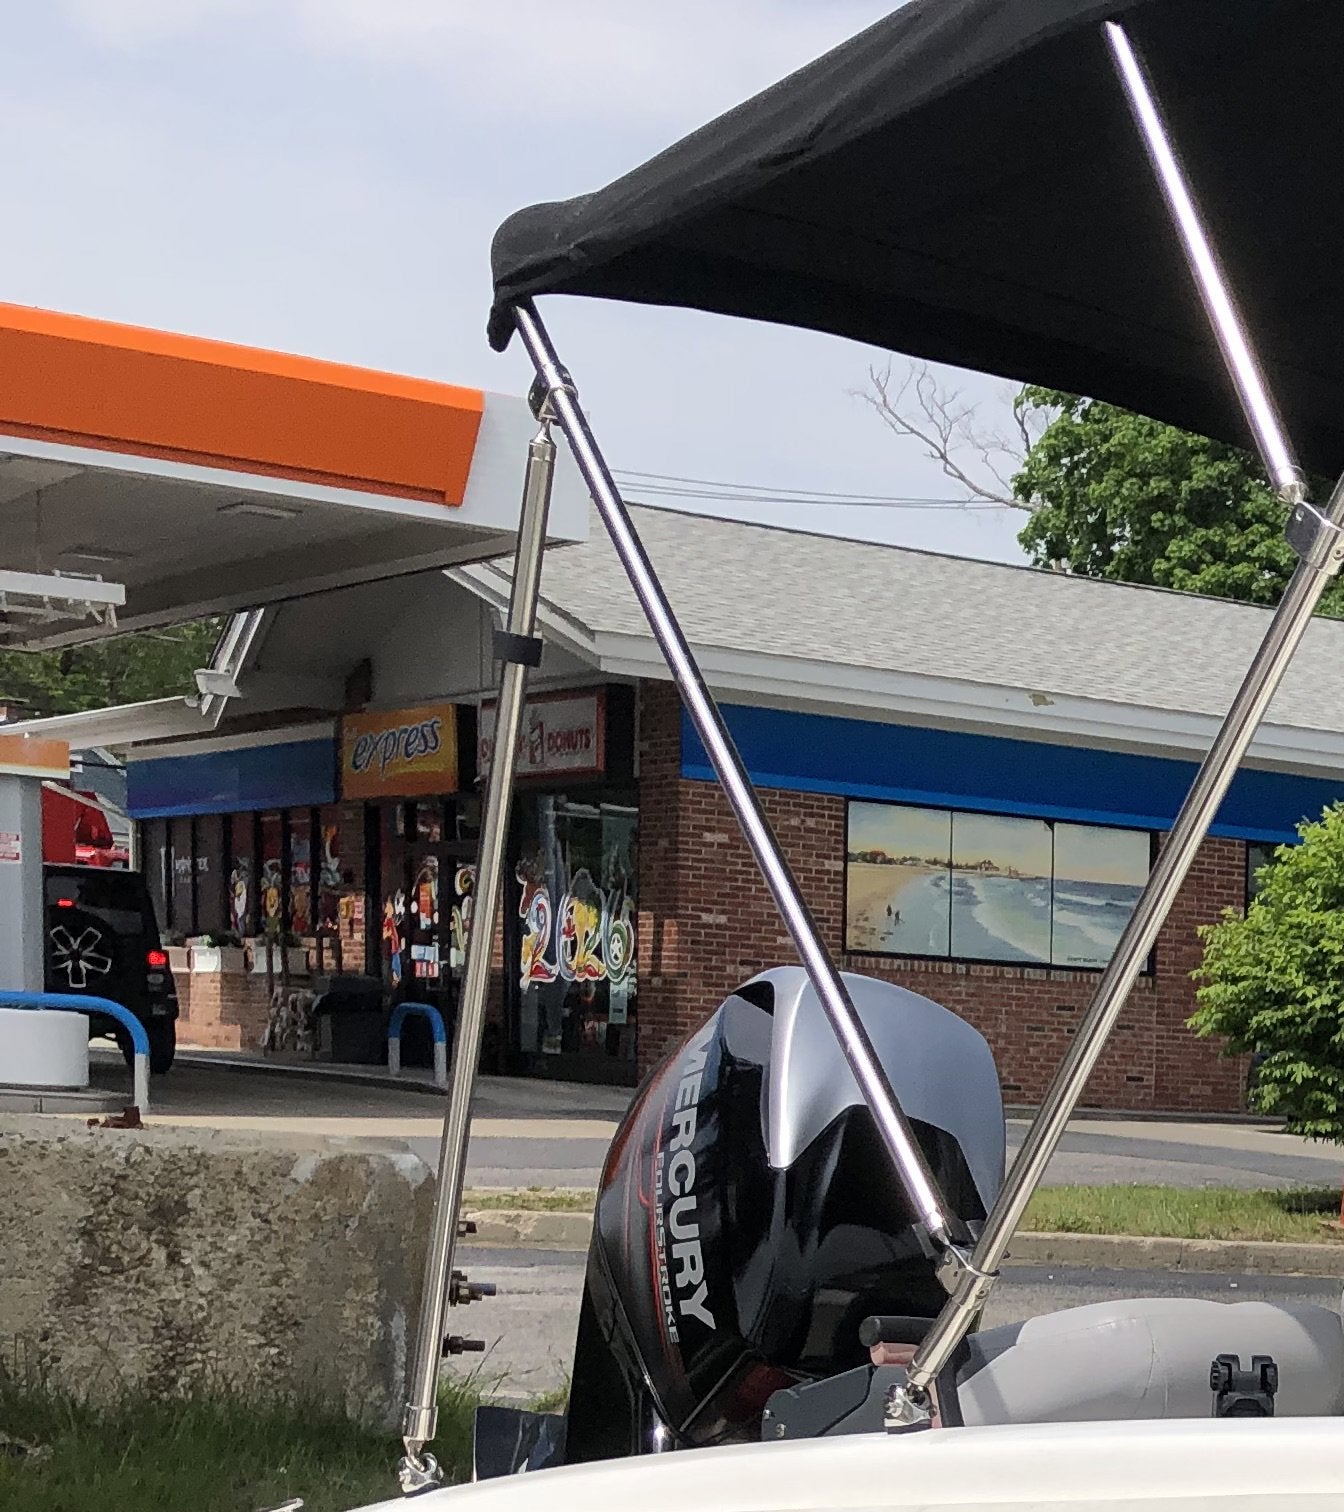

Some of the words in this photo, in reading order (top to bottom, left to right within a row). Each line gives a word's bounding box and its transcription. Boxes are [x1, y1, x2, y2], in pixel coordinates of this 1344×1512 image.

[351, 716, 442, 781] express
[547, 728, 592, 753] DONUTS
[668, 1022, 718, 1330] MERCURY
[655, 1151, 680, 1344] FOURSTROKE
